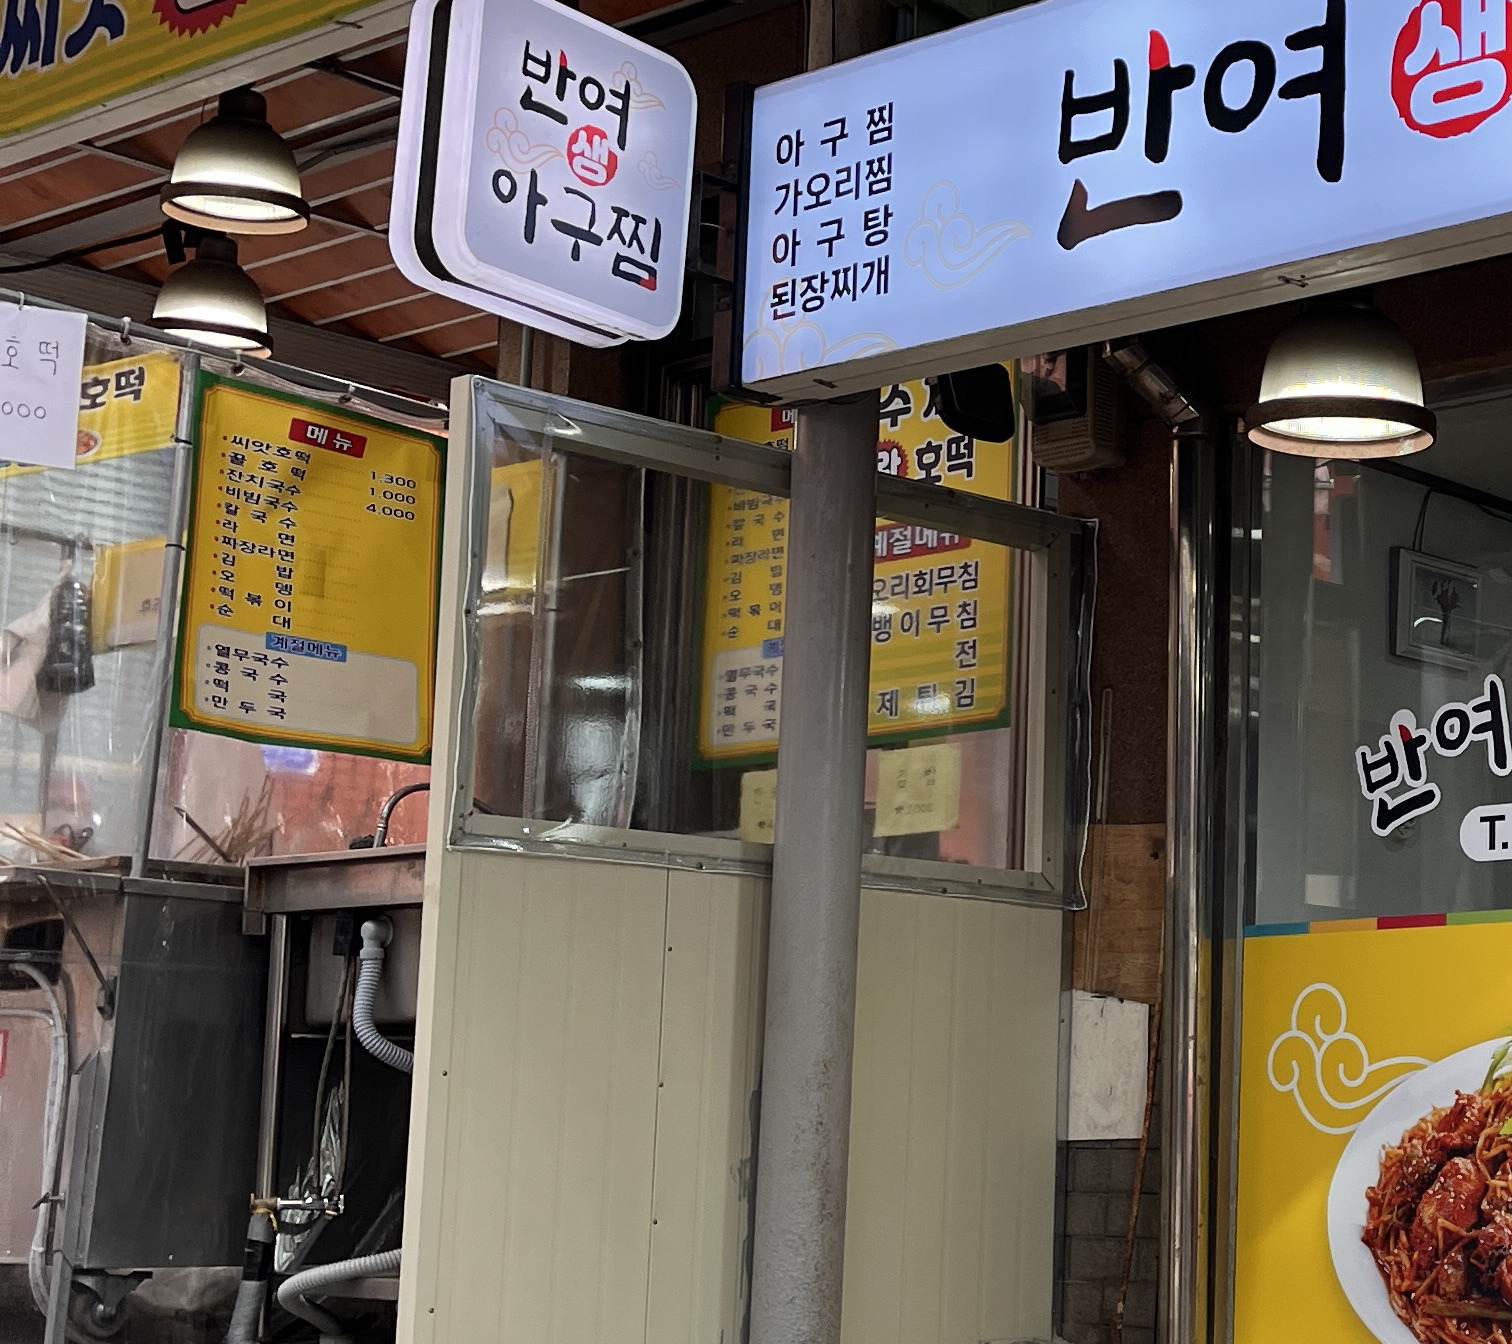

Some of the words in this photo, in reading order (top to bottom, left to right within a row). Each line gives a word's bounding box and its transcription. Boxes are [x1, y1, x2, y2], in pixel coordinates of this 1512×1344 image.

[520, 39, 630, 151] 반여
[570, 128, 613, 185] 생
[774, 152, 893, 216] 가오리찜
[492, 168, 661, 291] 아구찜
[770, 255, 890, 320] 된장찌개
[80, 366, 145, 411] 호떡
[230, 435, 311, 464] 씨앗호떡
[306, 424, 352, 451] 메뉴
[225, 485, 298, 513] 비빔국수
[227, 468, 301, 496] 잔치국수
[221, 535, 295, 563] 짜장라면
[214, 644, 289, 668] 열무국수
[272, 636, 342, 659] 계절메뉴
[1359, 677, 1510, 833] 반여
